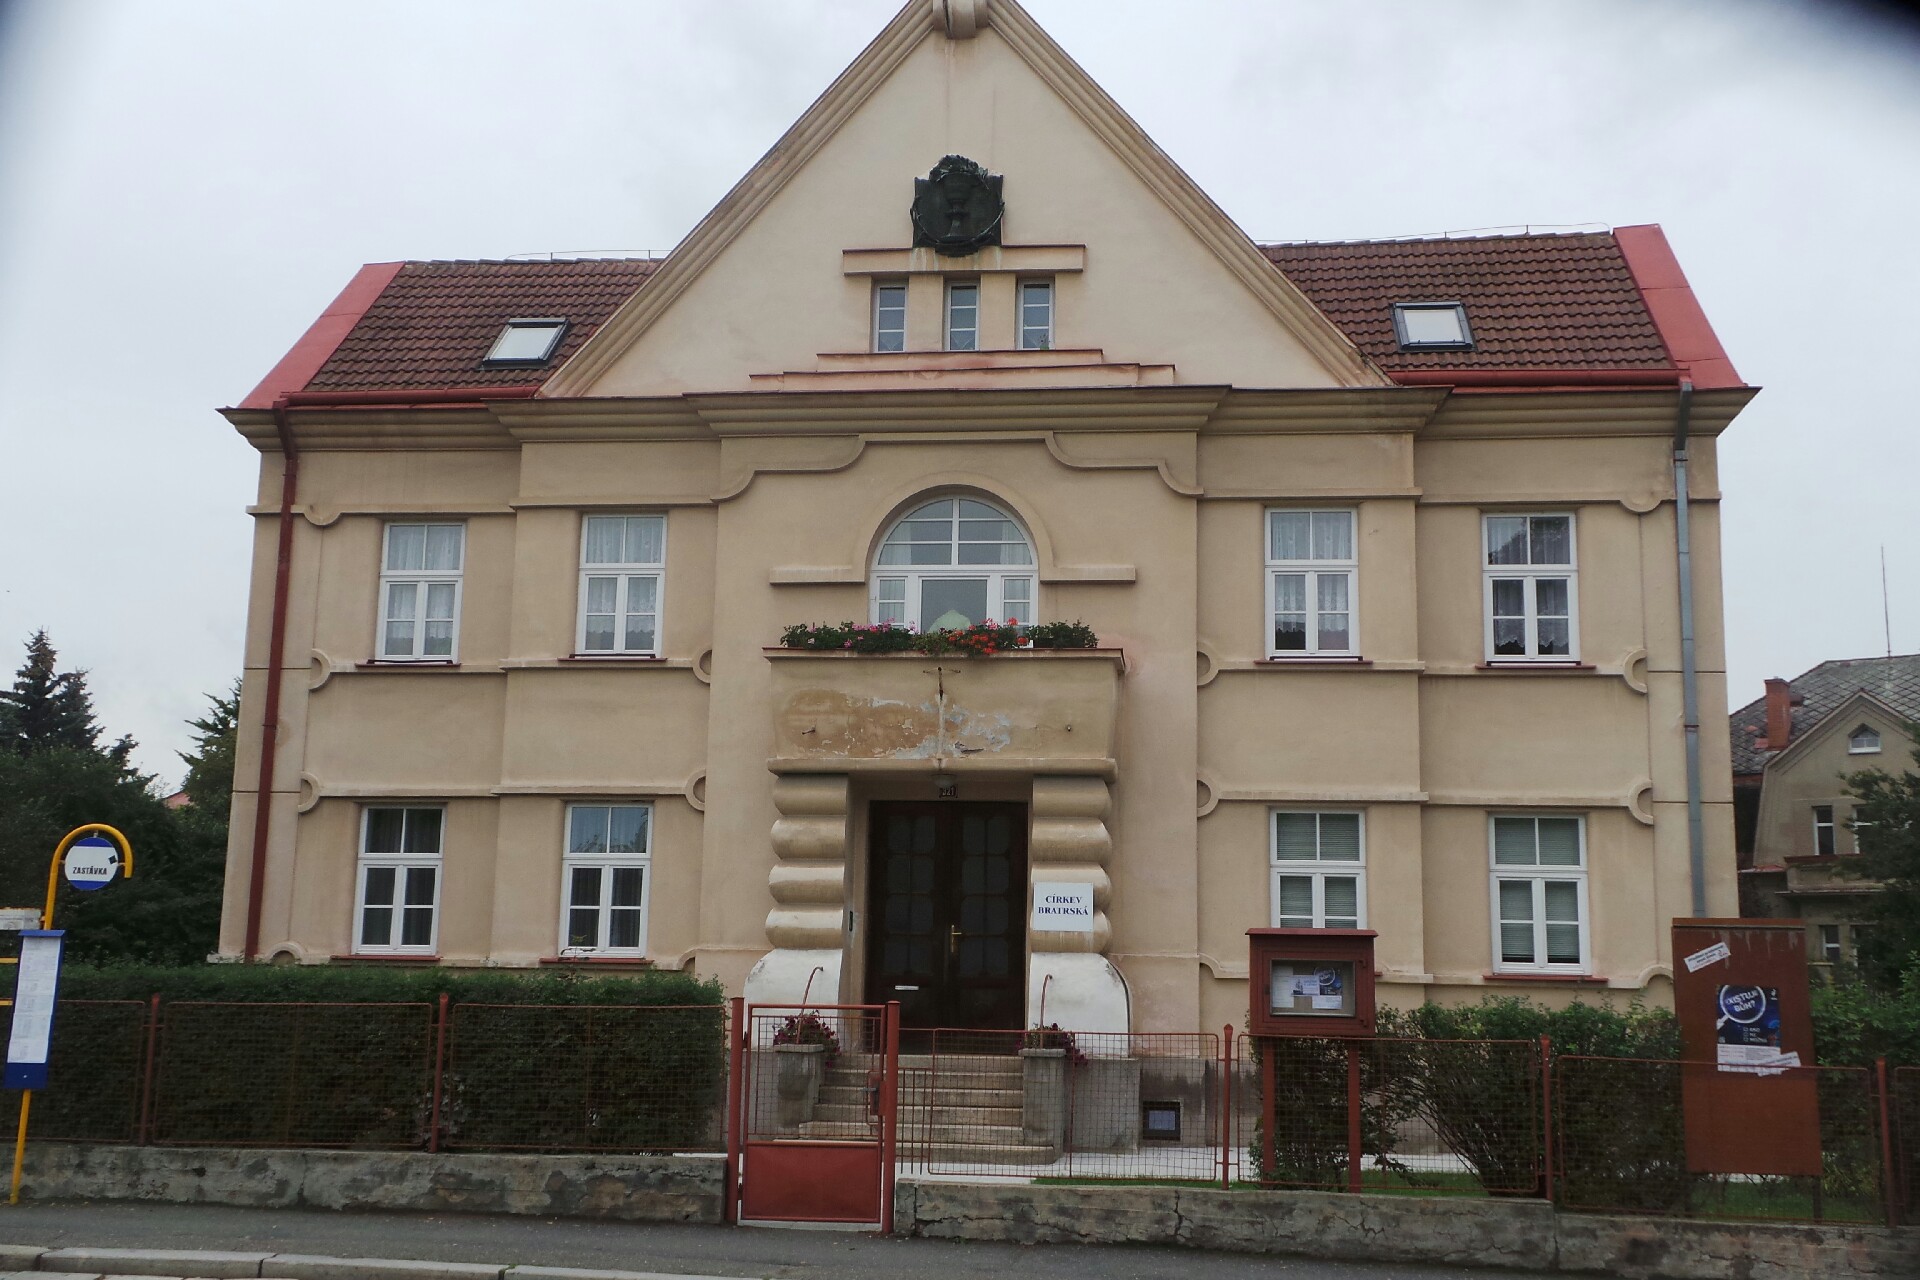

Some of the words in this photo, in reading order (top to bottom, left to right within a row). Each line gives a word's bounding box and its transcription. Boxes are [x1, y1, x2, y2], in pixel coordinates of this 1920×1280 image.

[72, 866, 107, 875] ZASTÁVKA
[1045, 893, 1082, 904] CÍRKEV
[1038, 906, 1088, 915] BRATRSKÁ
